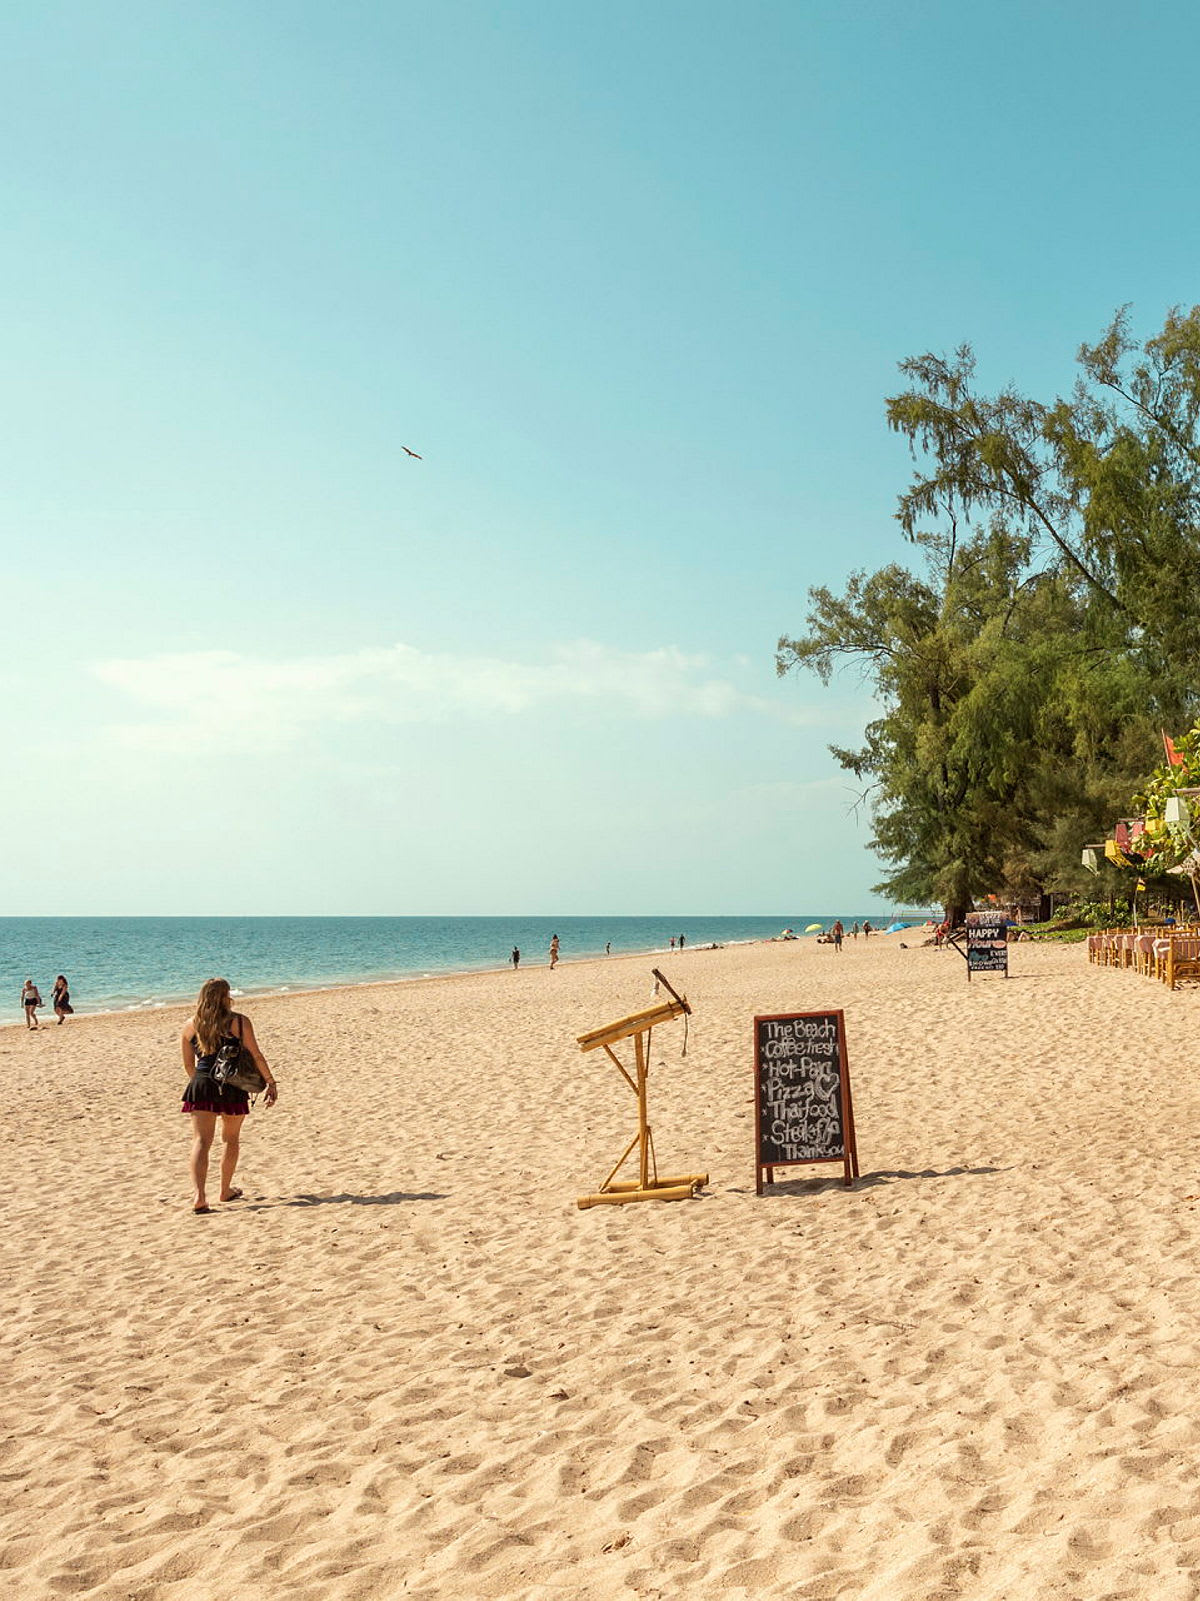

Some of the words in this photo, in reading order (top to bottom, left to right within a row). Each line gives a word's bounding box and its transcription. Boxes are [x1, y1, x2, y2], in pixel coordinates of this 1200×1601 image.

[968, 928, 999, 938] HAPPY
[763, 1021, 793, 1038] The
[793, 1018, 836, 1039] Beach
[766, 1037, 806, 1058] Coffee
[767, 1078, 814, 1102] Pizza
